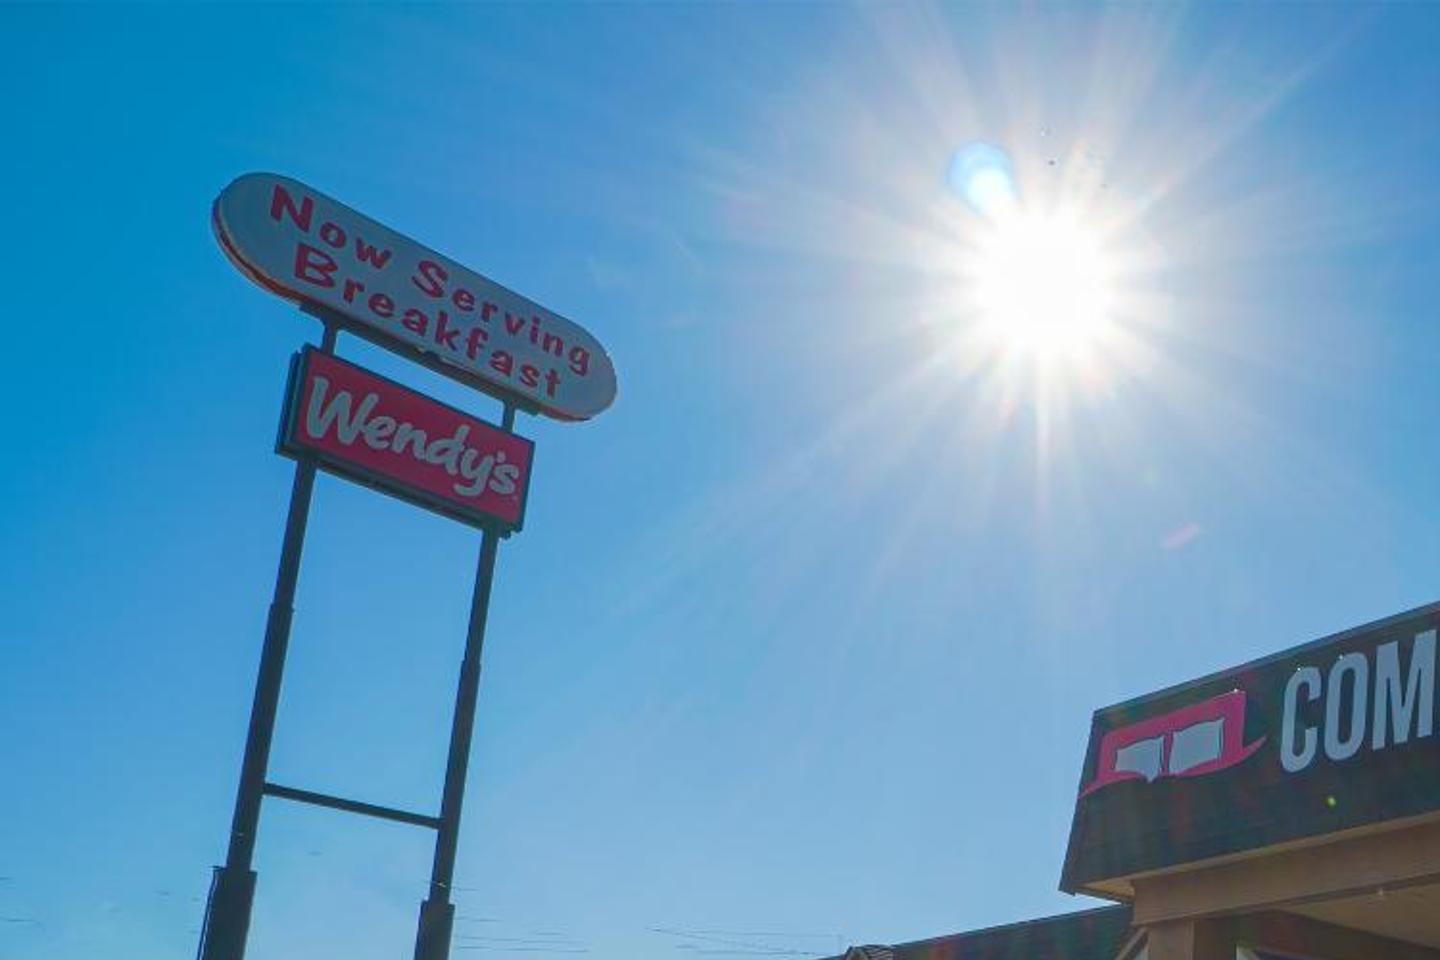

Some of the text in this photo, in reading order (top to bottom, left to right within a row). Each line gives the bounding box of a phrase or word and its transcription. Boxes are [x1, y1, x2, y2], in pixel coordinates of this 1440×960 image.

[270, 184, 592, 377] Now Serving
[294, 242, 562, 400] Breakfast
[306, 376, 520, 496] Wendy's
